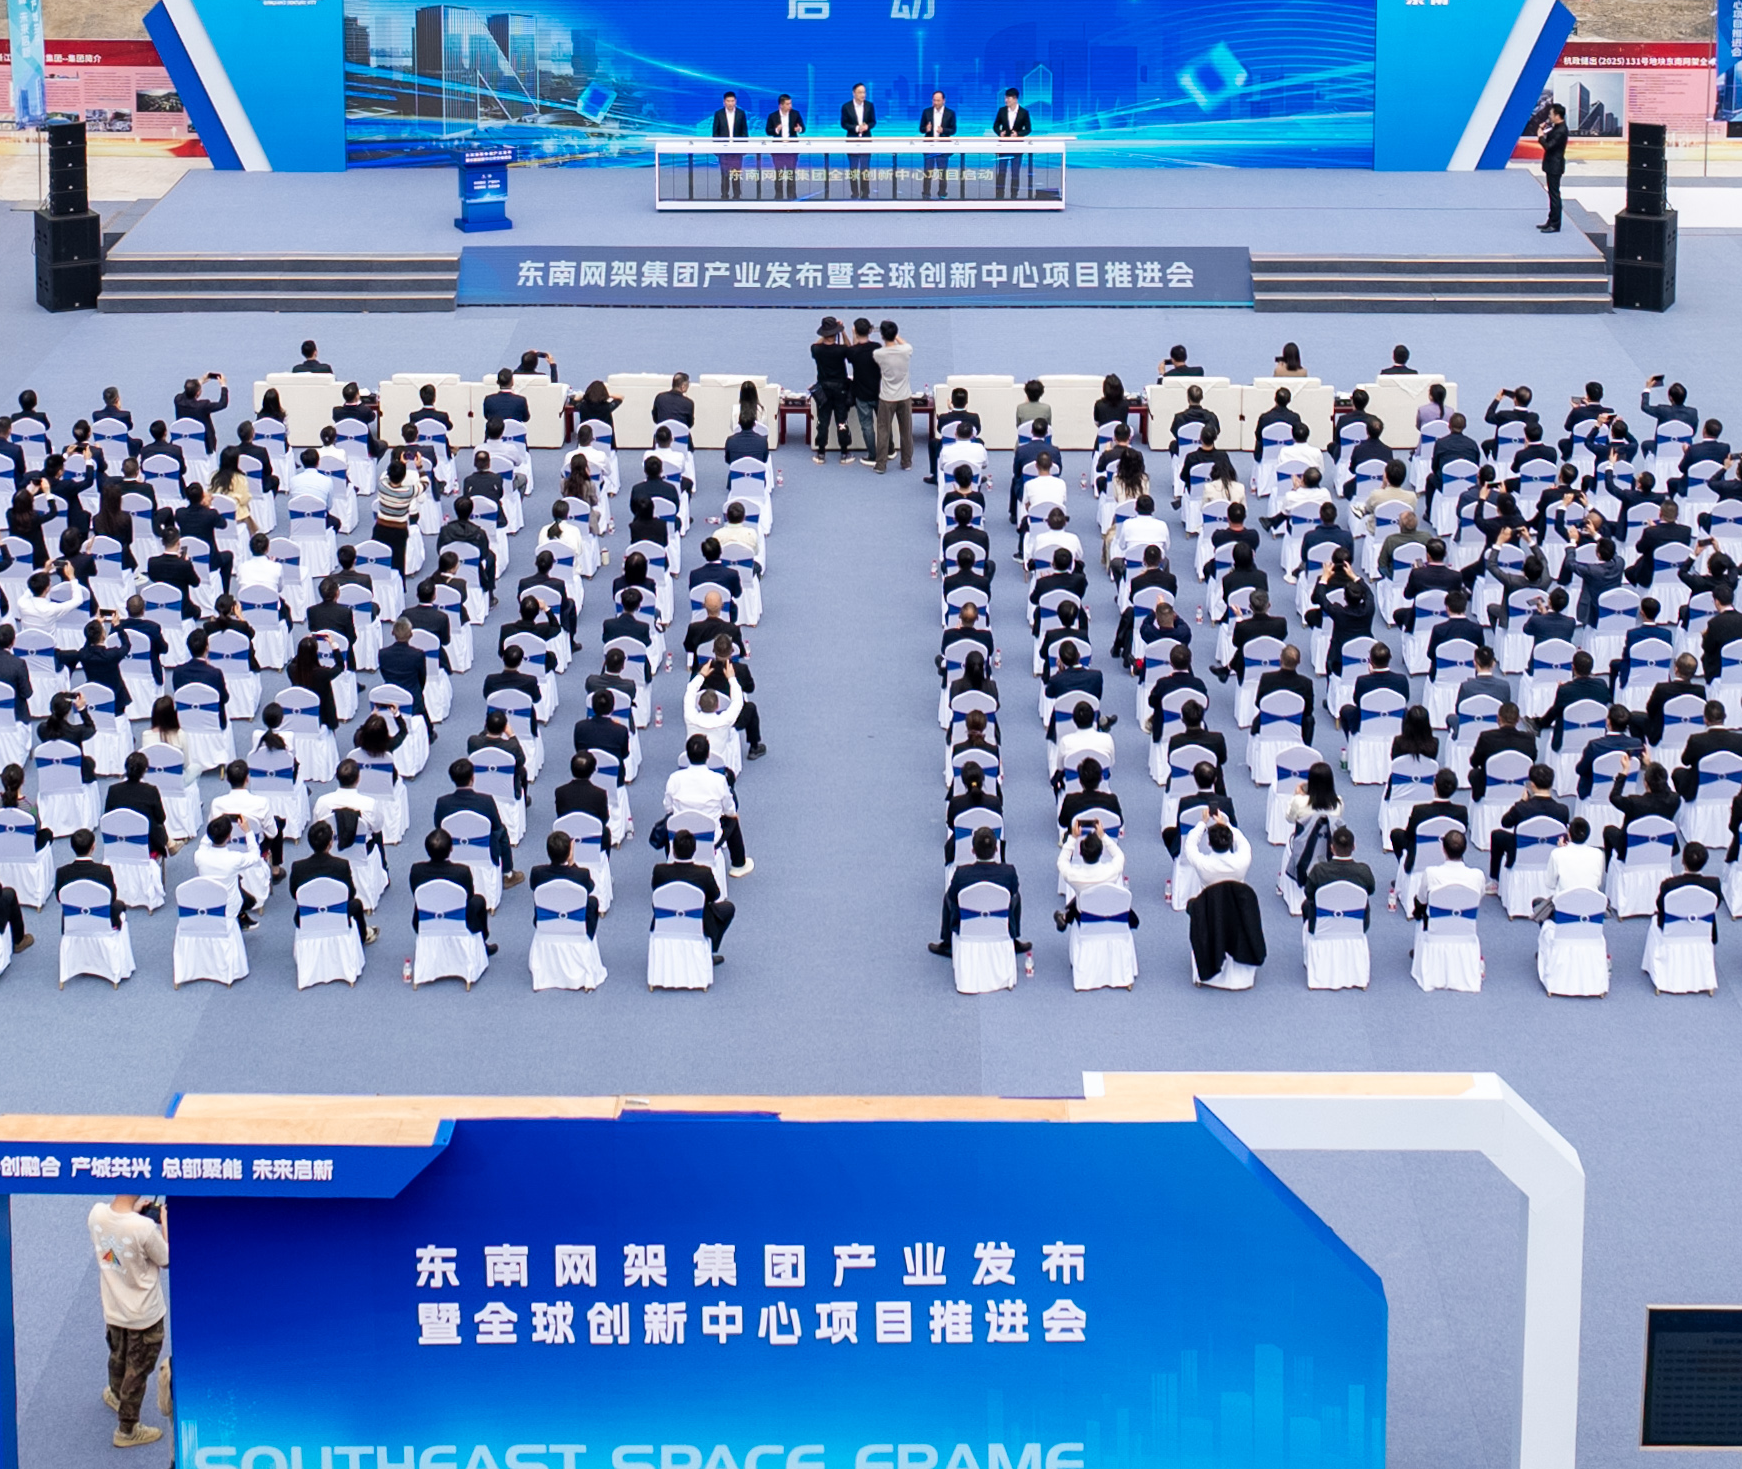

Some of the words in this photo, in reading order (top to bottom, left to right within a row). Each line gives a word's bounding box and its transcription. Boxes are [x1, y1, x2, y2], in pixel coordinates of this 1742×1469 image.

[729, 168, 995, 182] 东南网架集团全球创新中心项目启动
[517, 260, 1194, 289] 东南网架集团产业发布暨全球创新中心项目推进会
[71, 1156, 152, 1179] 产城共兴
[161, 1157, 243, 1180] 总部聚能
[252, 1158, 333, 1181] 未来启新
[415, 1240, 1086, 1288] 东南网架集团产业发布
[417, 1298, 1087, 1346] 暨全球创新中心项目推进会
